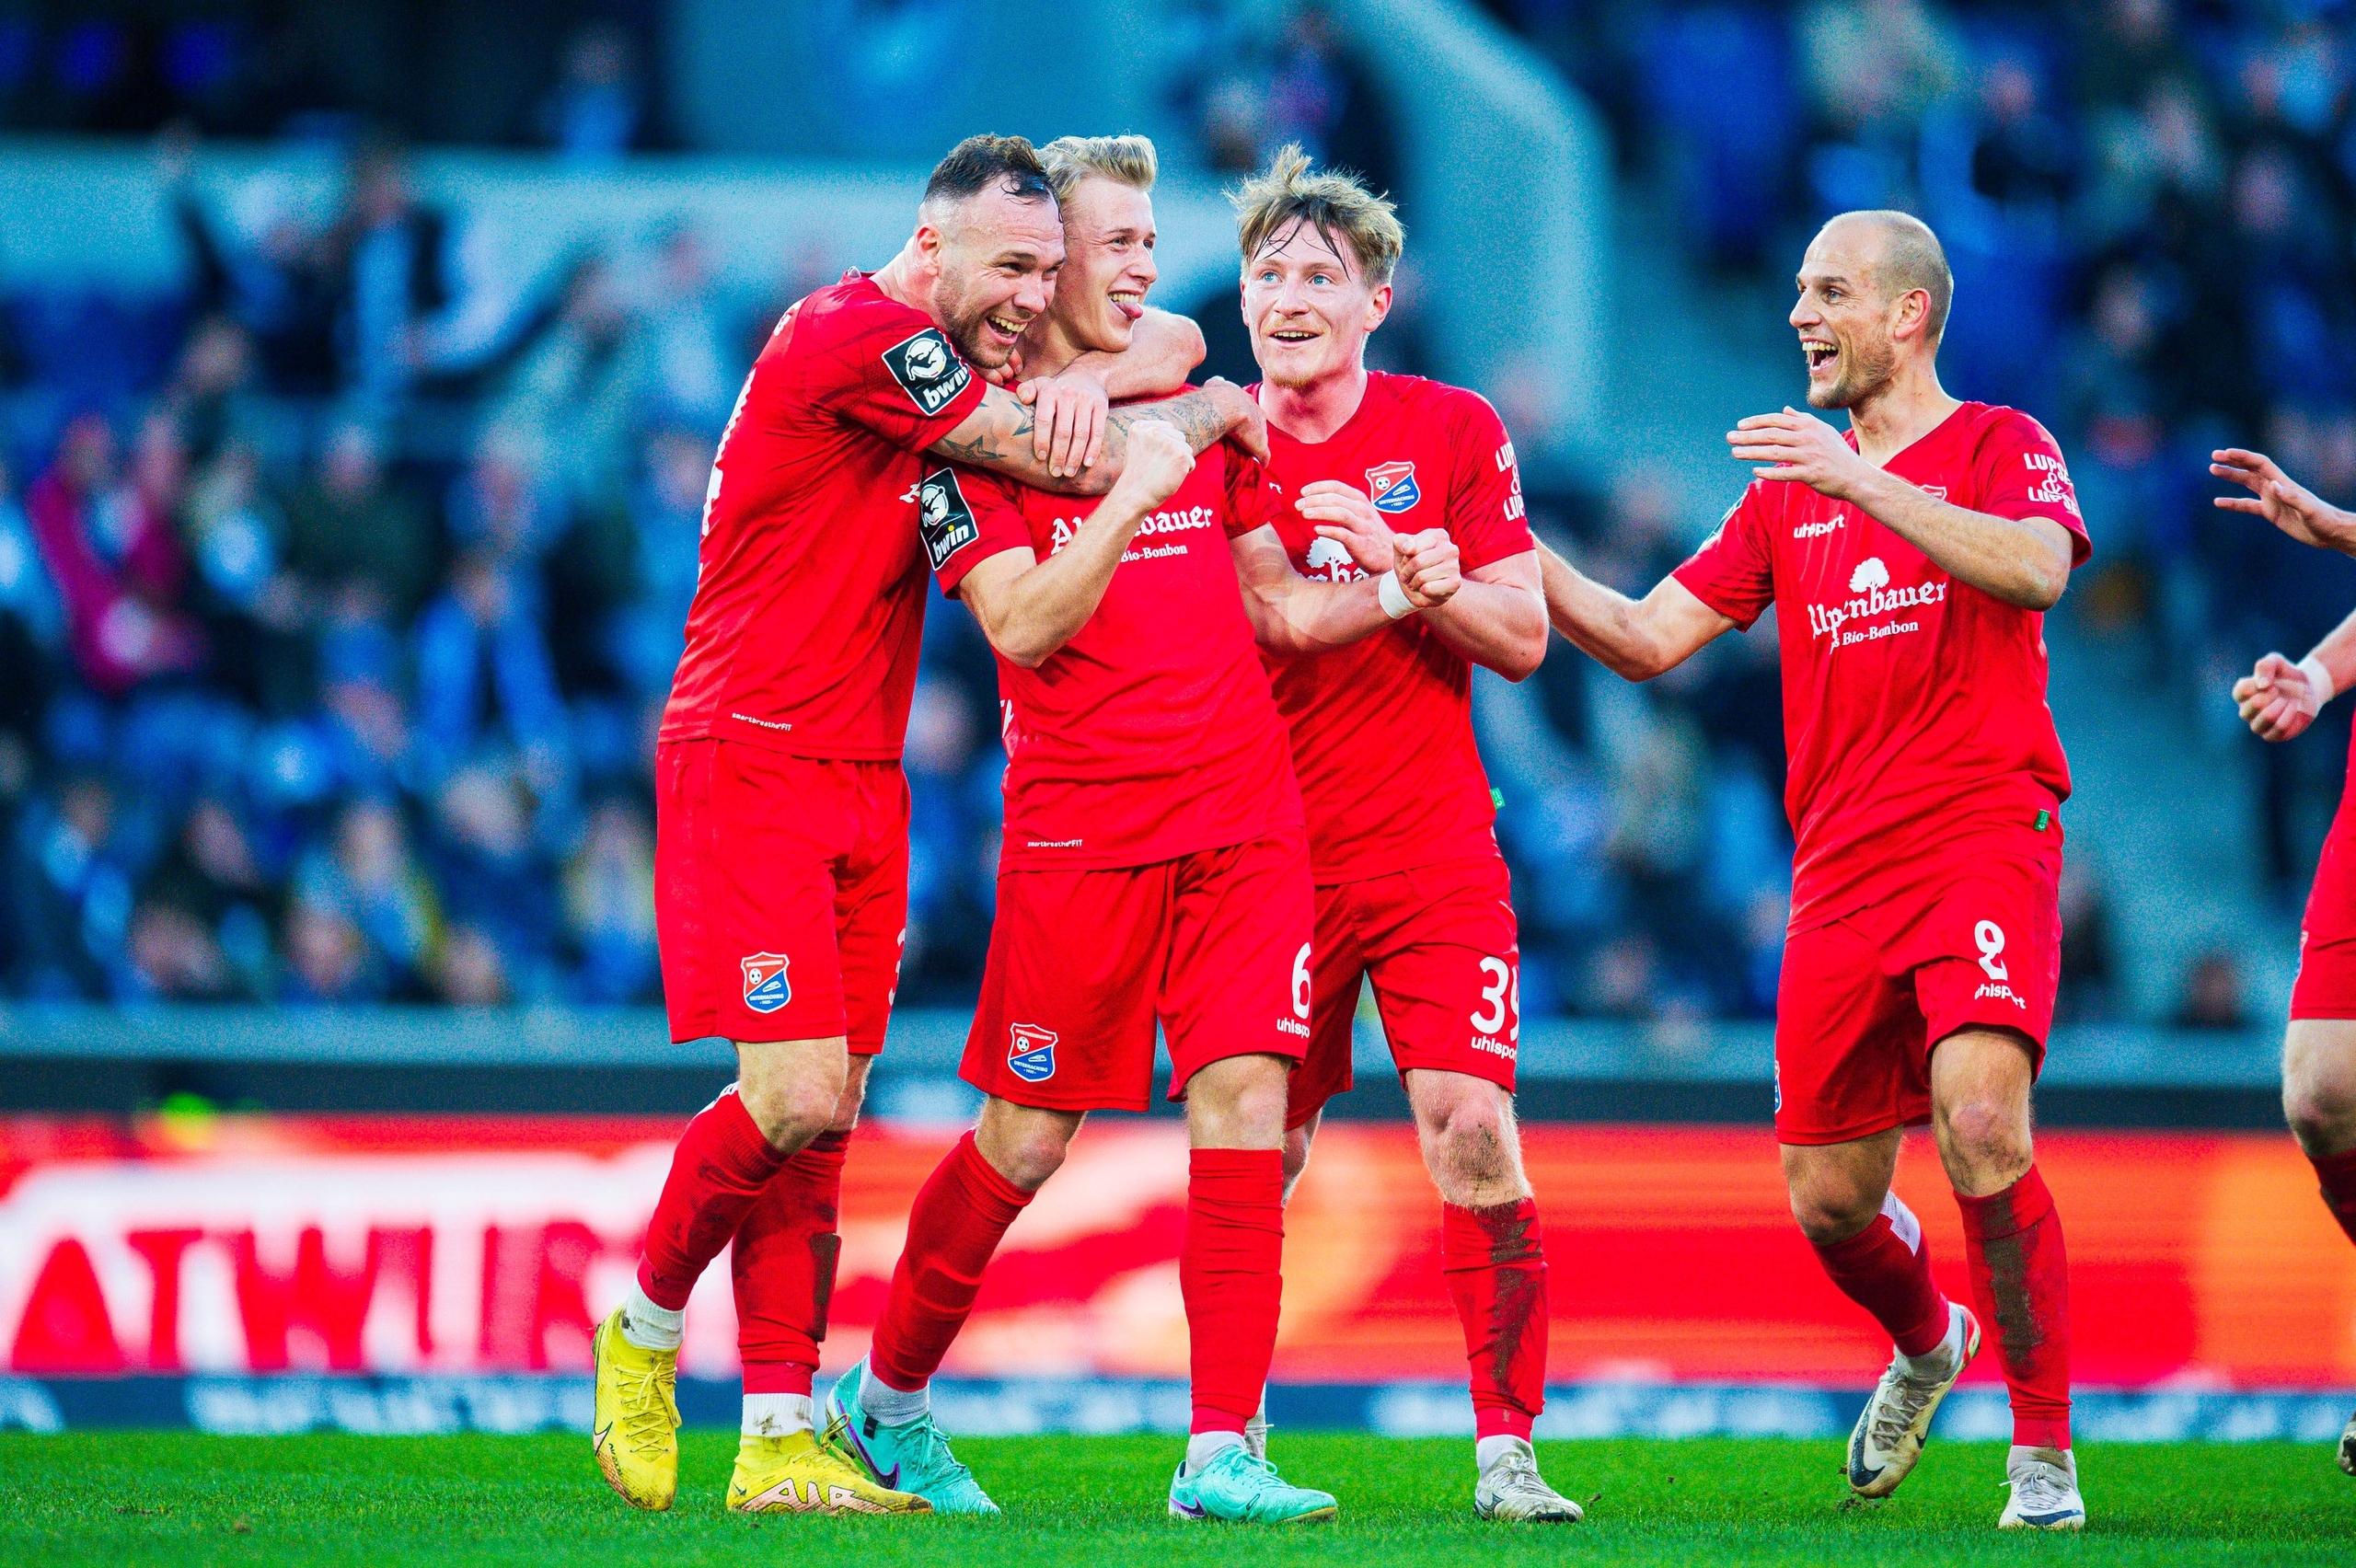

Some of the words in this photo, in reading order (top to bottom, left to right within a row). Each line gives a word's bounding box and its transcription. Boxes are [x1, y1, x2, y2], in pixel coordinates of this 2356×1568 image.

[932, 525, 969, 562] bwin
[1794, 513, 1845, 538] uhsport
[1292, 941, 1311, 1020] 6
